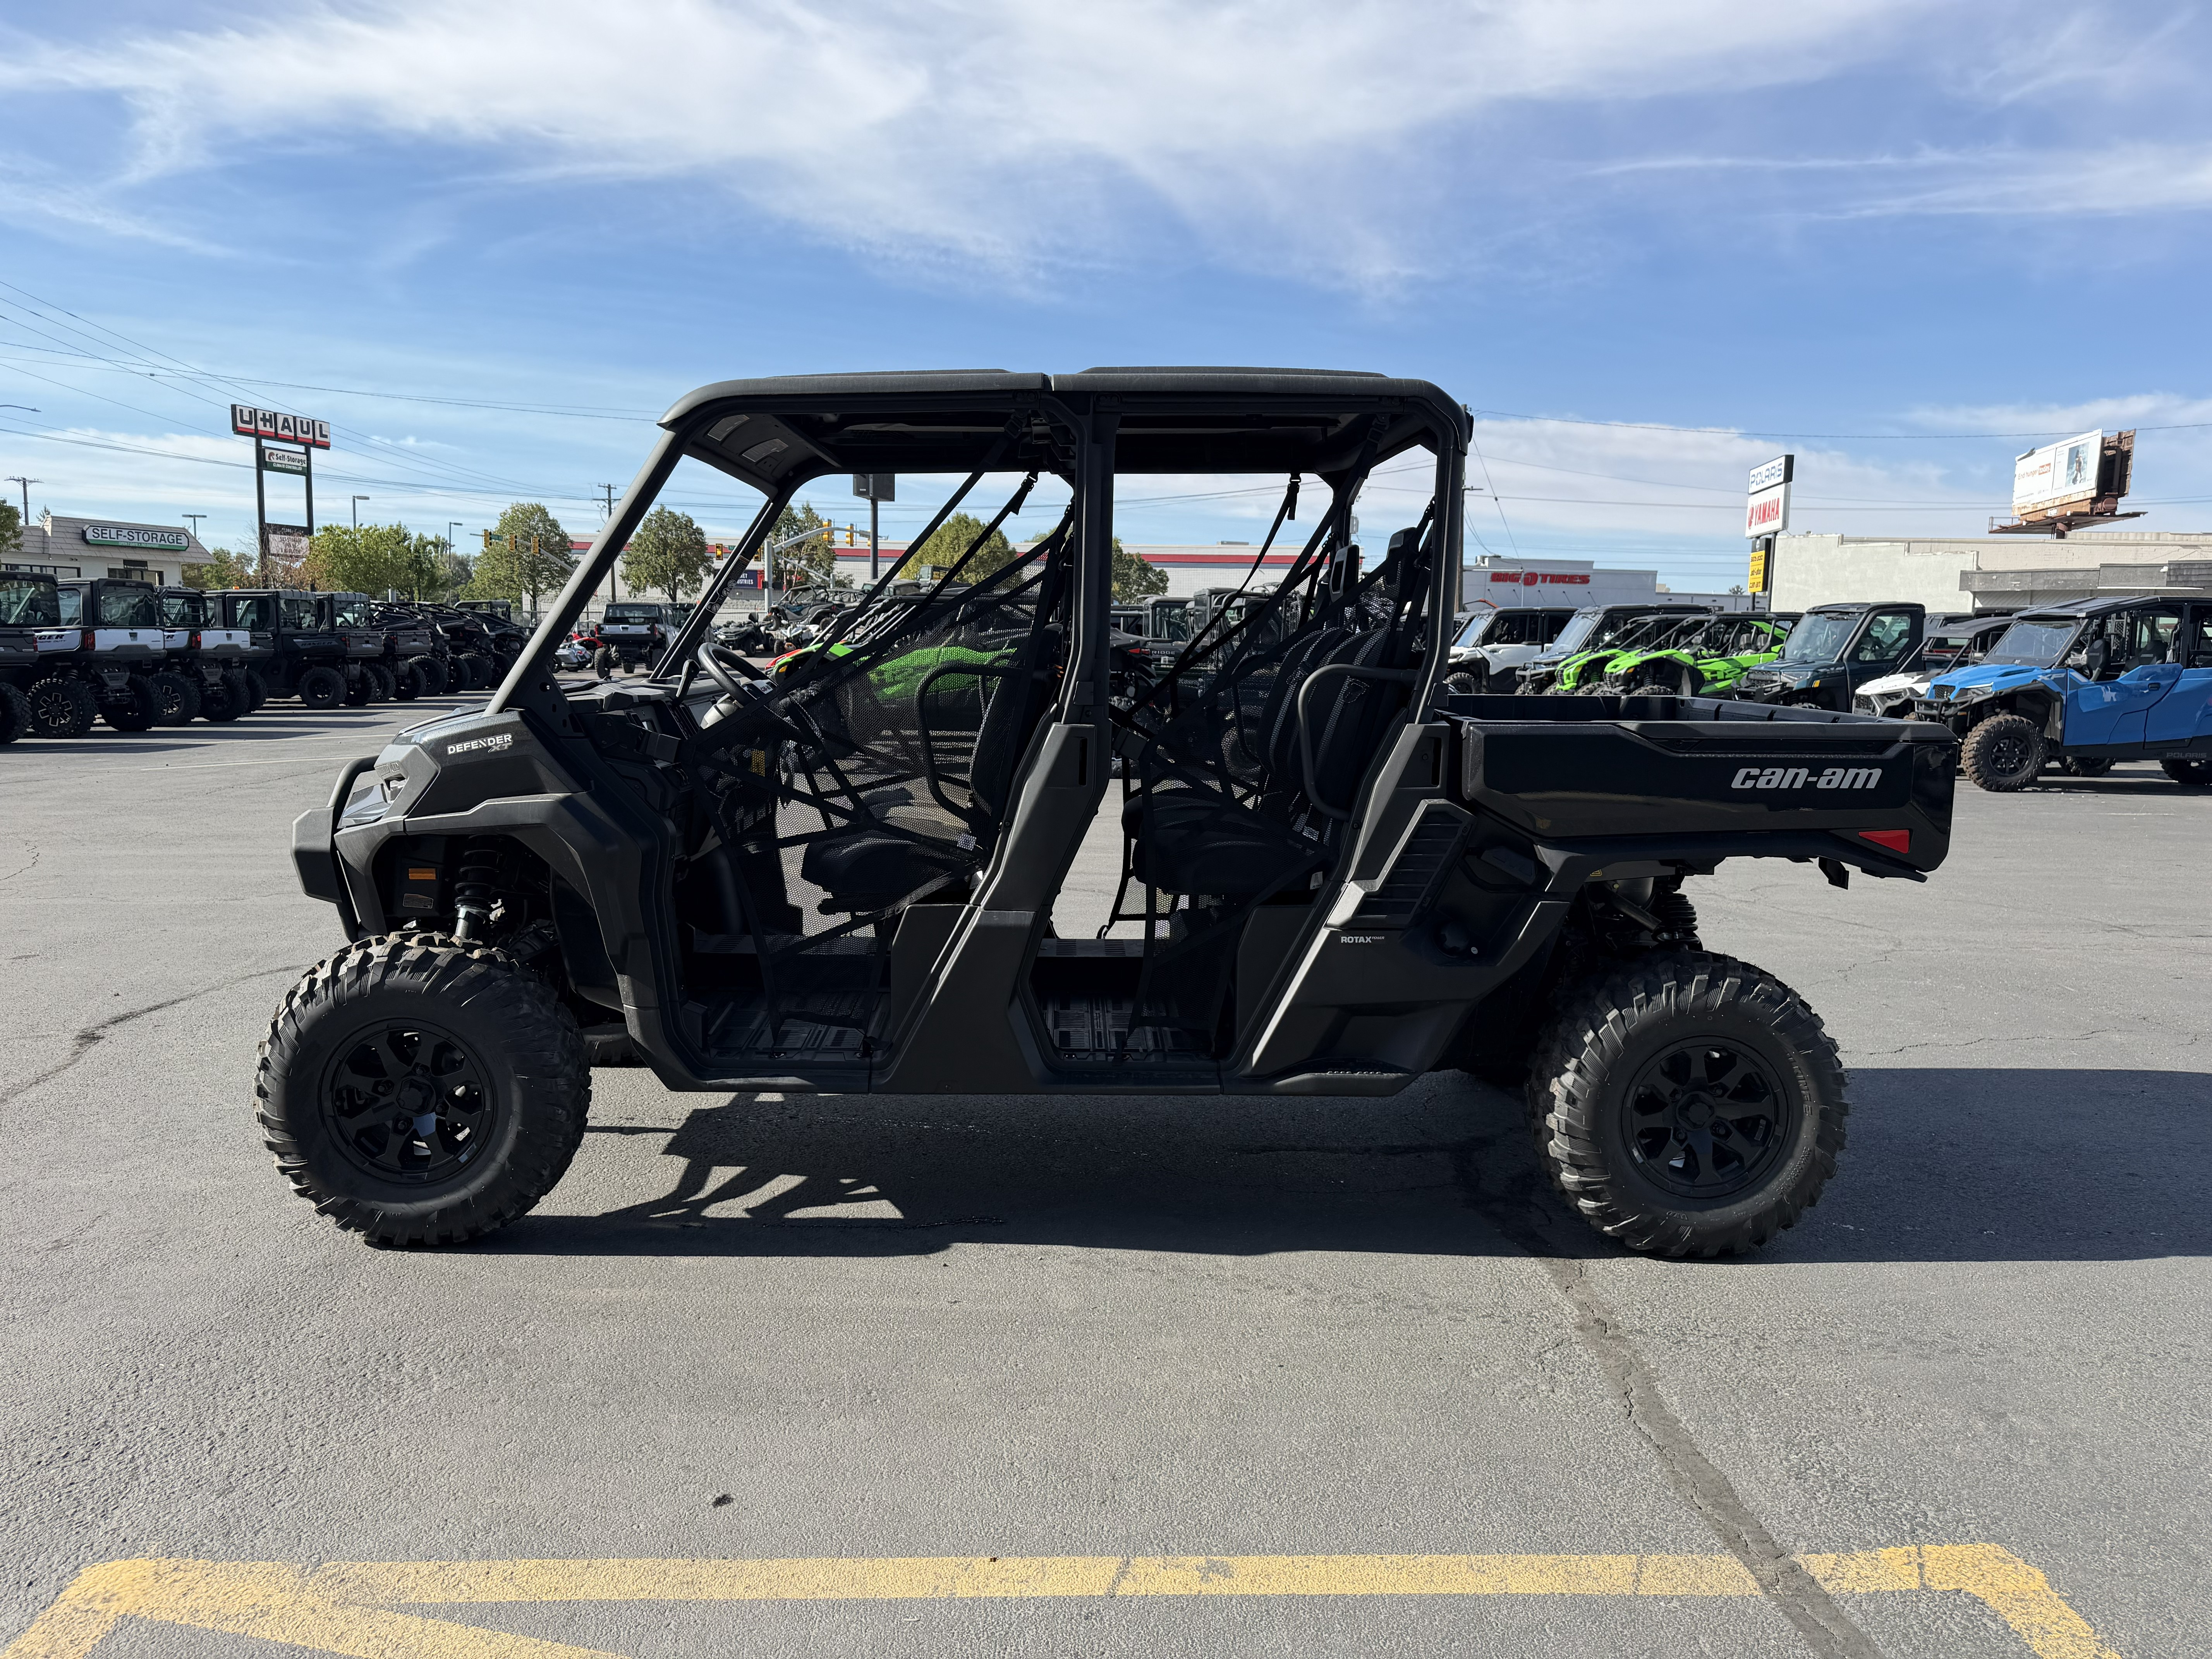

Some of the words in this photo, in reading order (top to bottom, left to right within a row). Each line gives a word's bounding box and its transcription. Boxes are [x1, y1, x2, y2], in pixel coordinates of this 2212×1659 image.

[276, 453, 306, 465] Self-Storage
[1750, 462, 1783, 488] POLARIS
[1755, 498, 1779, 526] YAMAHA
[92, 528, 183, 544] SELF-STORAGE
[1491, 572, 1522, 582] BIG
[1523, 572, 1539, 586] O
[1539, 574, 1590, 584] TIRES
[448, 734, 512, 754] DEFENDER
[488, 742, 512, 752] XT
[1731, 768, 1882, 788] can-am
